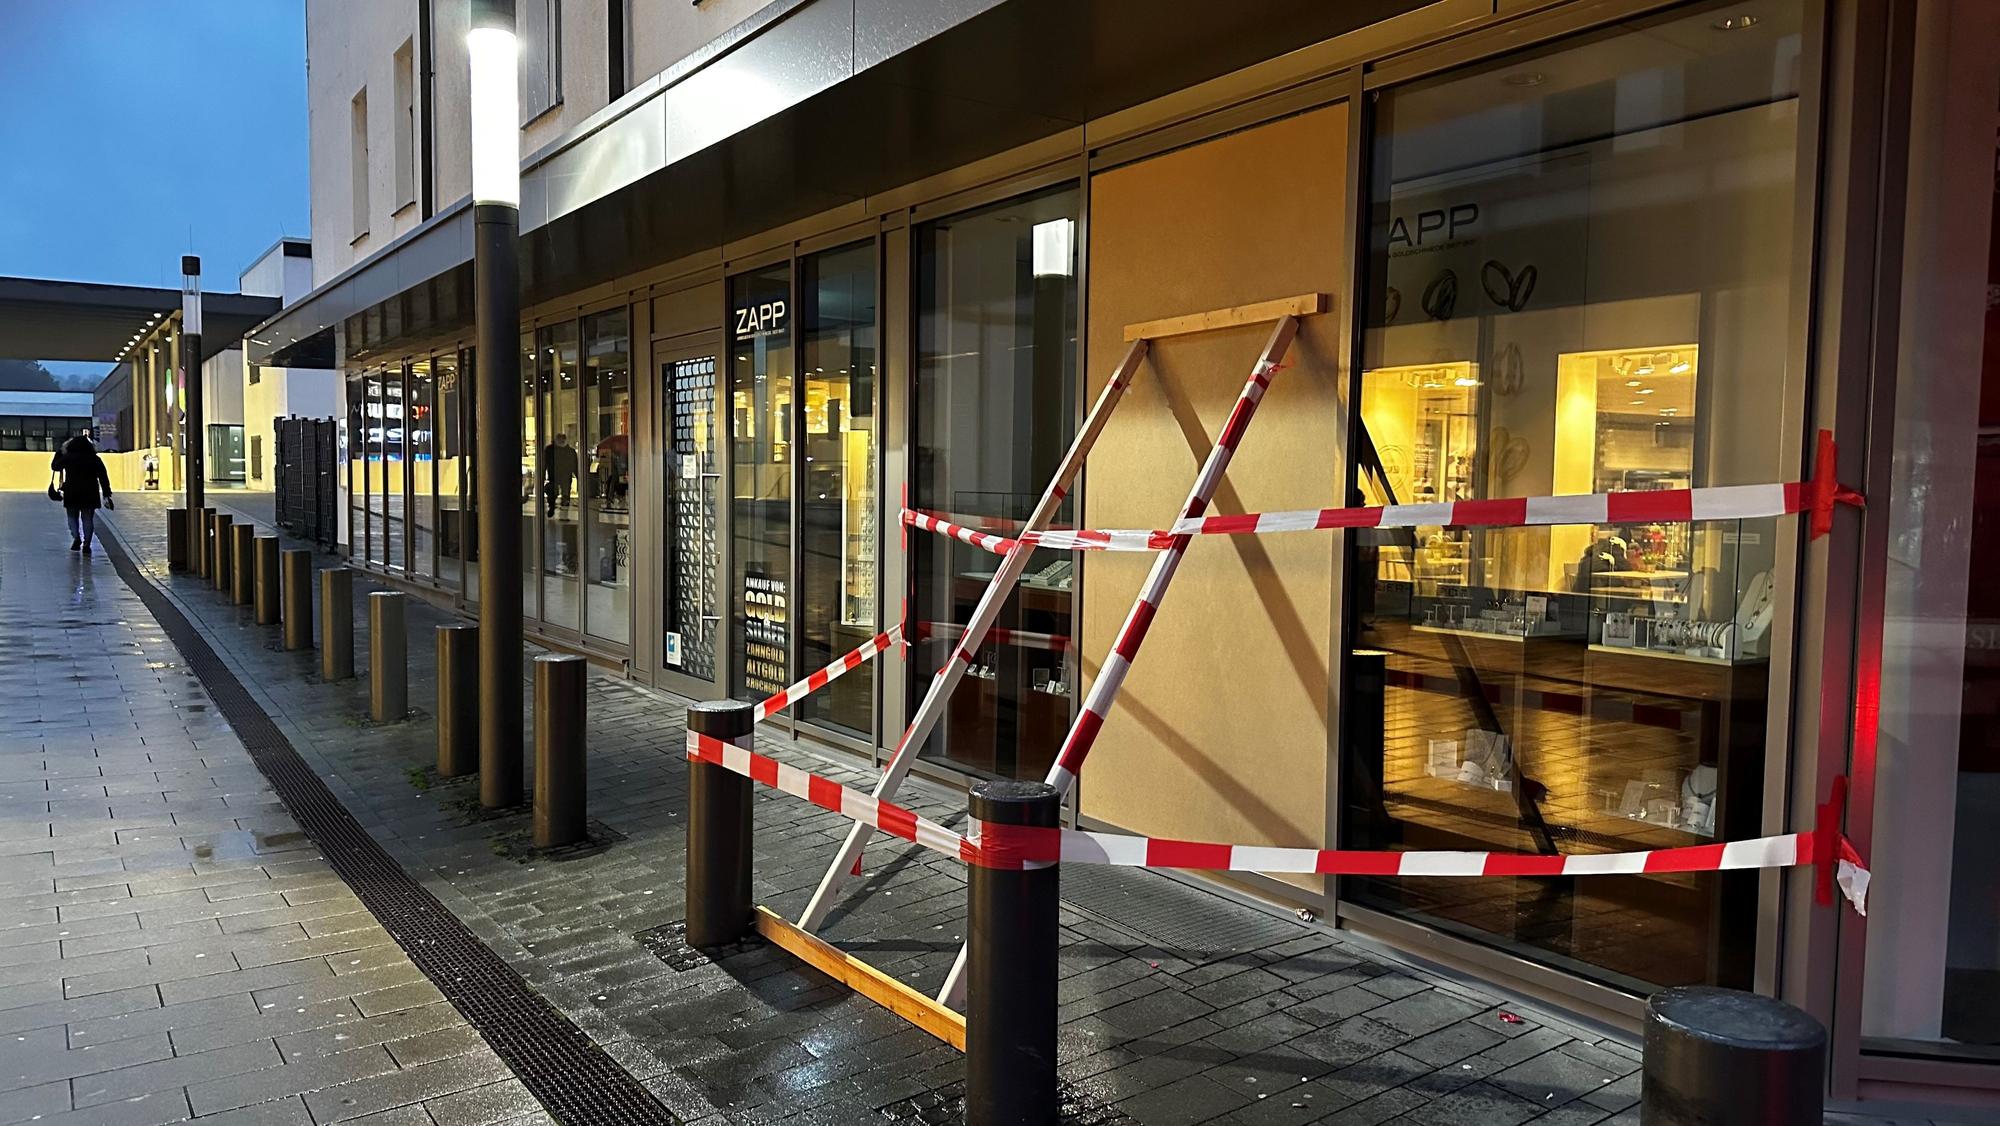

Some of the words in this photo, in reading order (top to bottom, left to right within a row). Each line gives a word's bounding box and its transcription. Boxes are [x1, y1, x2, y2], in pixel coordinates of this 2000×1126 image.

[1387, 203, 1479, 247] APP
[736, 300, 785, 334] ZAPP
[437, 373, 456, 391] ZAPP
[746, 577, 770, 591] ANKAUF
[771, 580, 786, 594] VON:
[745, 590, 785, 623] GOLD
[763, 611, 771, 627] &
[745, 620, 785, 648] SILBER
[746, 642, 785, 664] ZAHNGOLD
[746, 658, 785, 682] ALTGOLD
[746, 676, 784, 694] BRUCHGOLD
